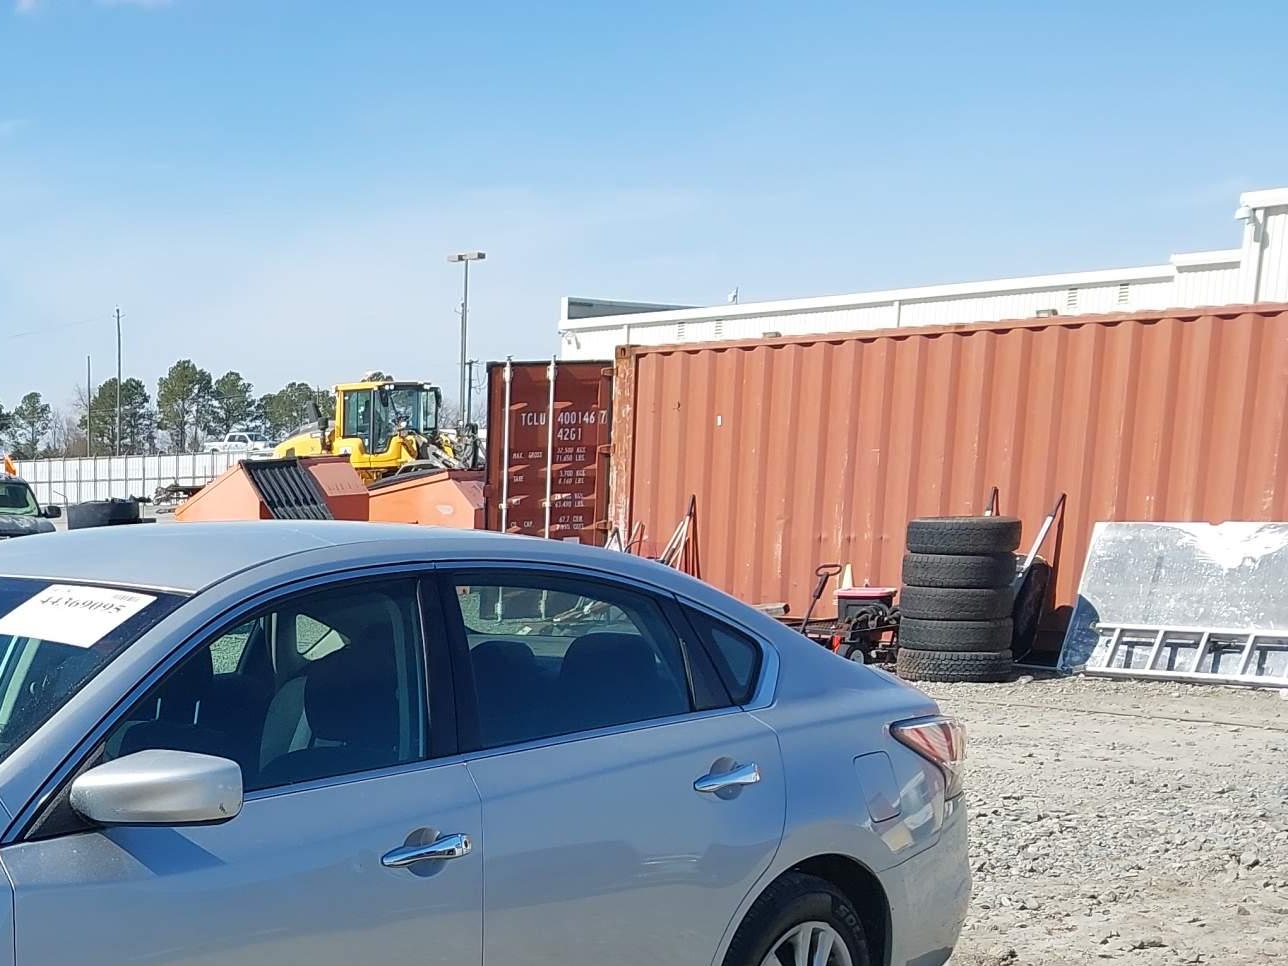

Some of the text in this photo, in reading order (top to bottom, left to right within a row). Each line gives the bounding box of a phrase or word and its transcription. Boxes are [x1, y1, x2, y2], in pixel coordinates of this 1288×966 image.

[521, 409, 608, 426] TCLU 400146 7
[557, 427, 582, 441] 42G1
